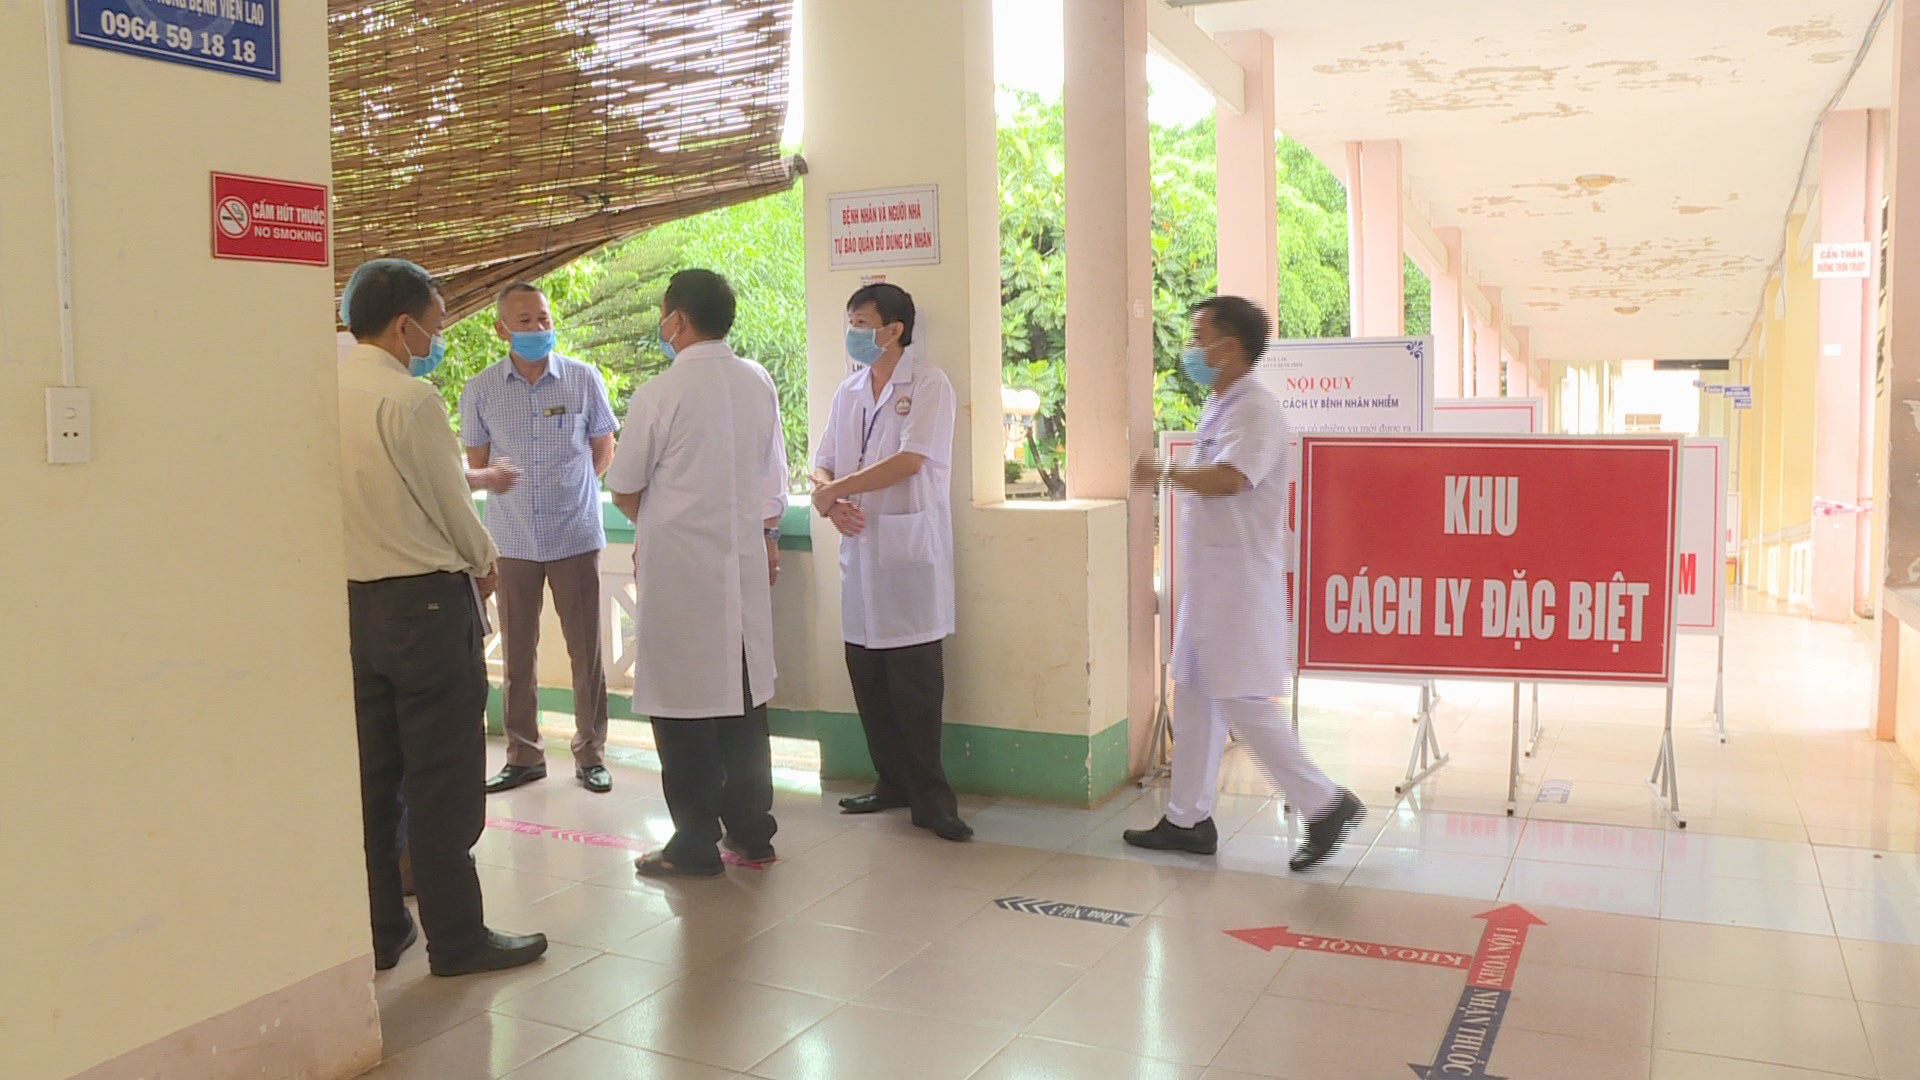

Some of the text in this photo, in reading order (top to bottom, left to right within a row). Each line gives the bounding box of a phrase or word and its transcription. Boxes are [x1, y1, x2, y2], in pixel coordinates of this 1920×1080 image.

[244, 1, 264, 26] LAO
[101, 10, 256, 63] 0964 59 18 18
[252, 198, 325, 226] CẤM HÚT THUỐC
[843, 204, 859, 227] BỆNH
[860, 203, 877, 223] NHÂN
[888, 200, 907, 222] NGƯỜI
[908, 199, 921, 220] NHÀ
[254, 226, 322, 243] NO SMOKING
[914, 227, 931, 248] NHÂN
[1286, 376, 1354, 393] NỘI QUY
[1282, 397, 1308, 409] CÁCH
[1310, 399, 1319, 409] LY
[1321, 397, 1343, 411] BỆNH
[1344, 397, 1370, 409] NHÂN
[1444, 475, 1518, 536] KHU
[1679, 553, 1696, 595] M
[1324, 566, 1423, 635] CÁCH
[1434, 578, 1472, 636] LY
[1481, 569, 1556, 650] ĐẶC
[1568, 571, 1650, 653] BIỆT
[1087, 909, 1124, 924] Khoa
[1298, 937, 1464, 967] KHOA NỘI 2
[1487, 932, 1521, 953] NỘI
[1475, 953, 1510, 987] KHOA
[1442, 987, 1500, 1077] NHẬN THUỐC
